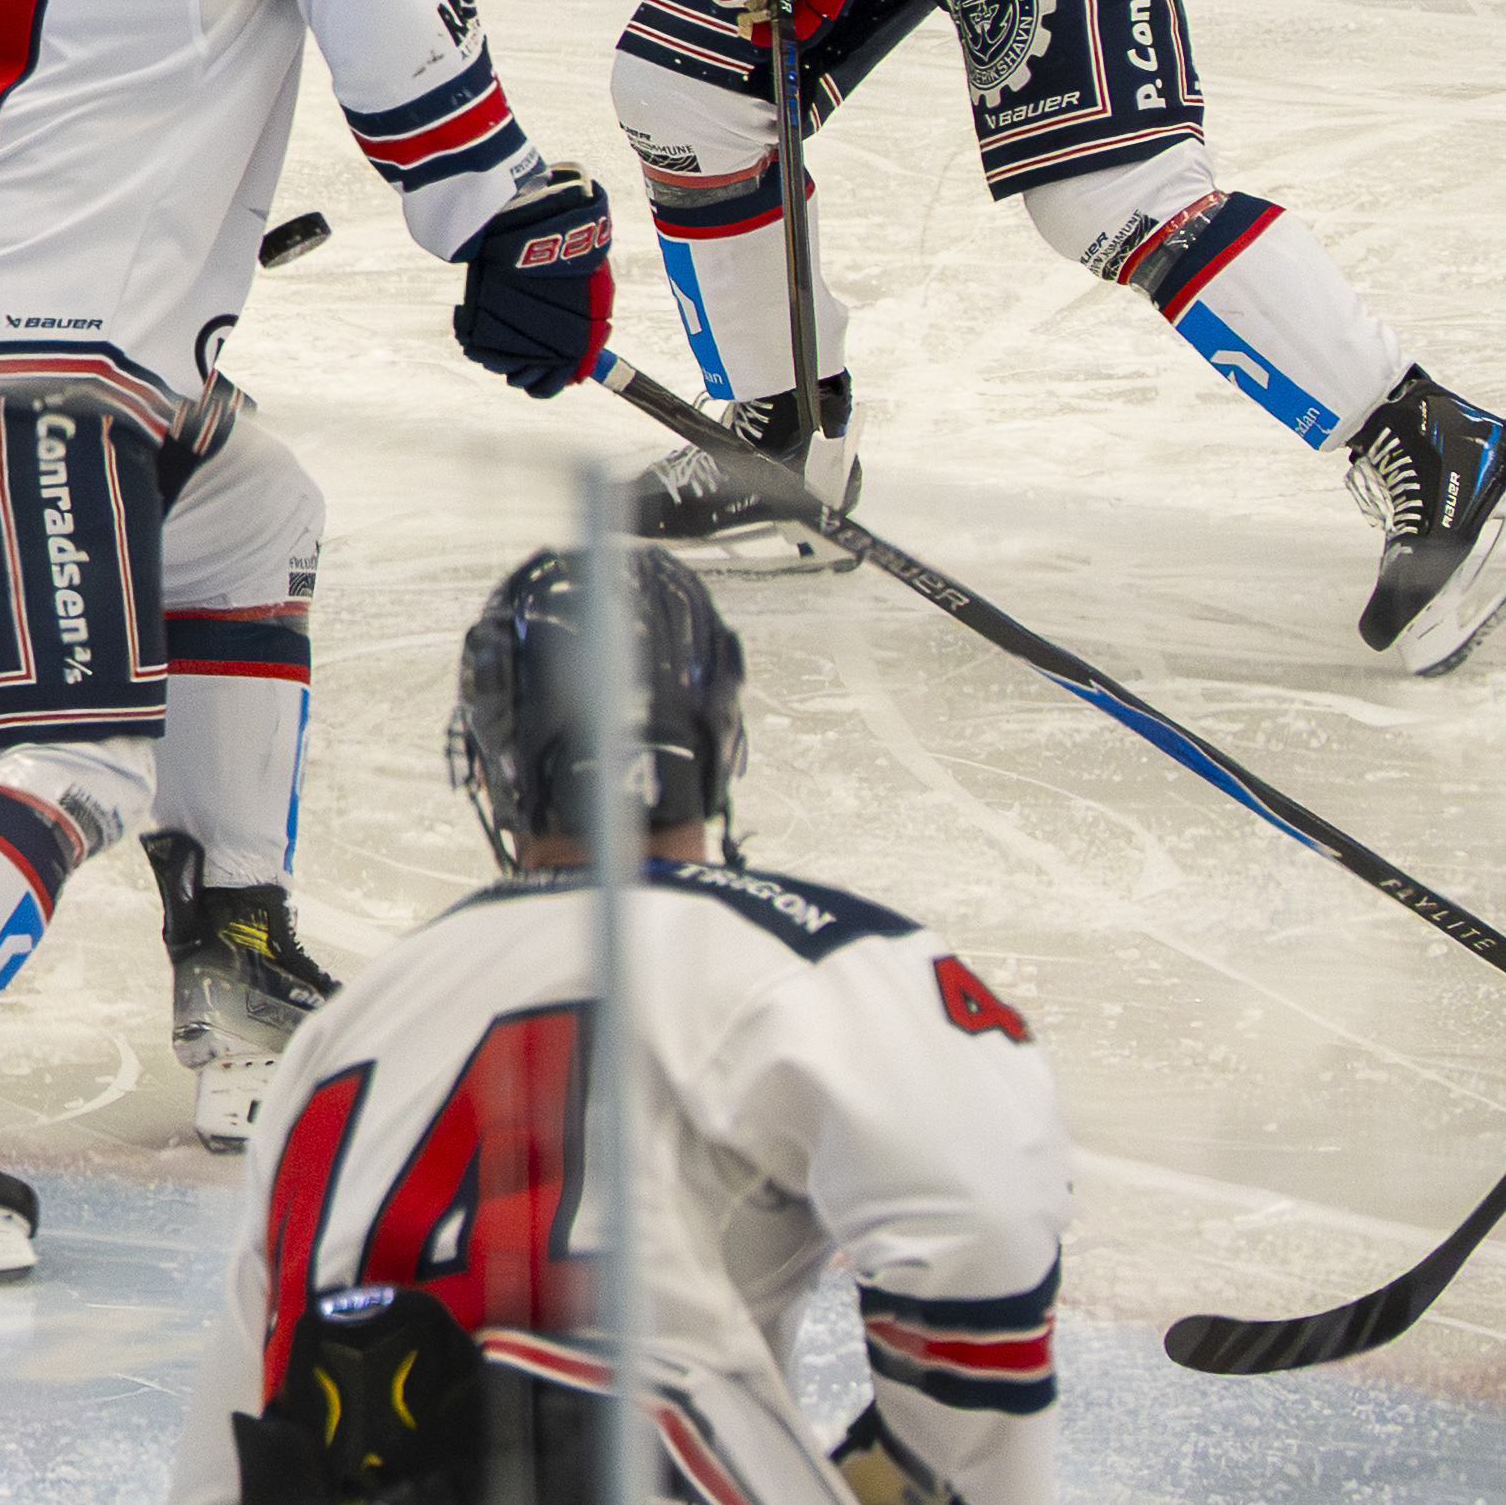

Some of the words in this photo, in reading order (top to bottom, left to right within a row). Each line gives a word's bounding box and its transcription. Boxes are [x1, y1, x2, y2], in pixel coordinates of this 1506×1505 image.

[1136, 78, 1167, 111] P.
[34, 412, 91, 653] Conradsen
[1378, 876, 1496, 953] FLYLITE
